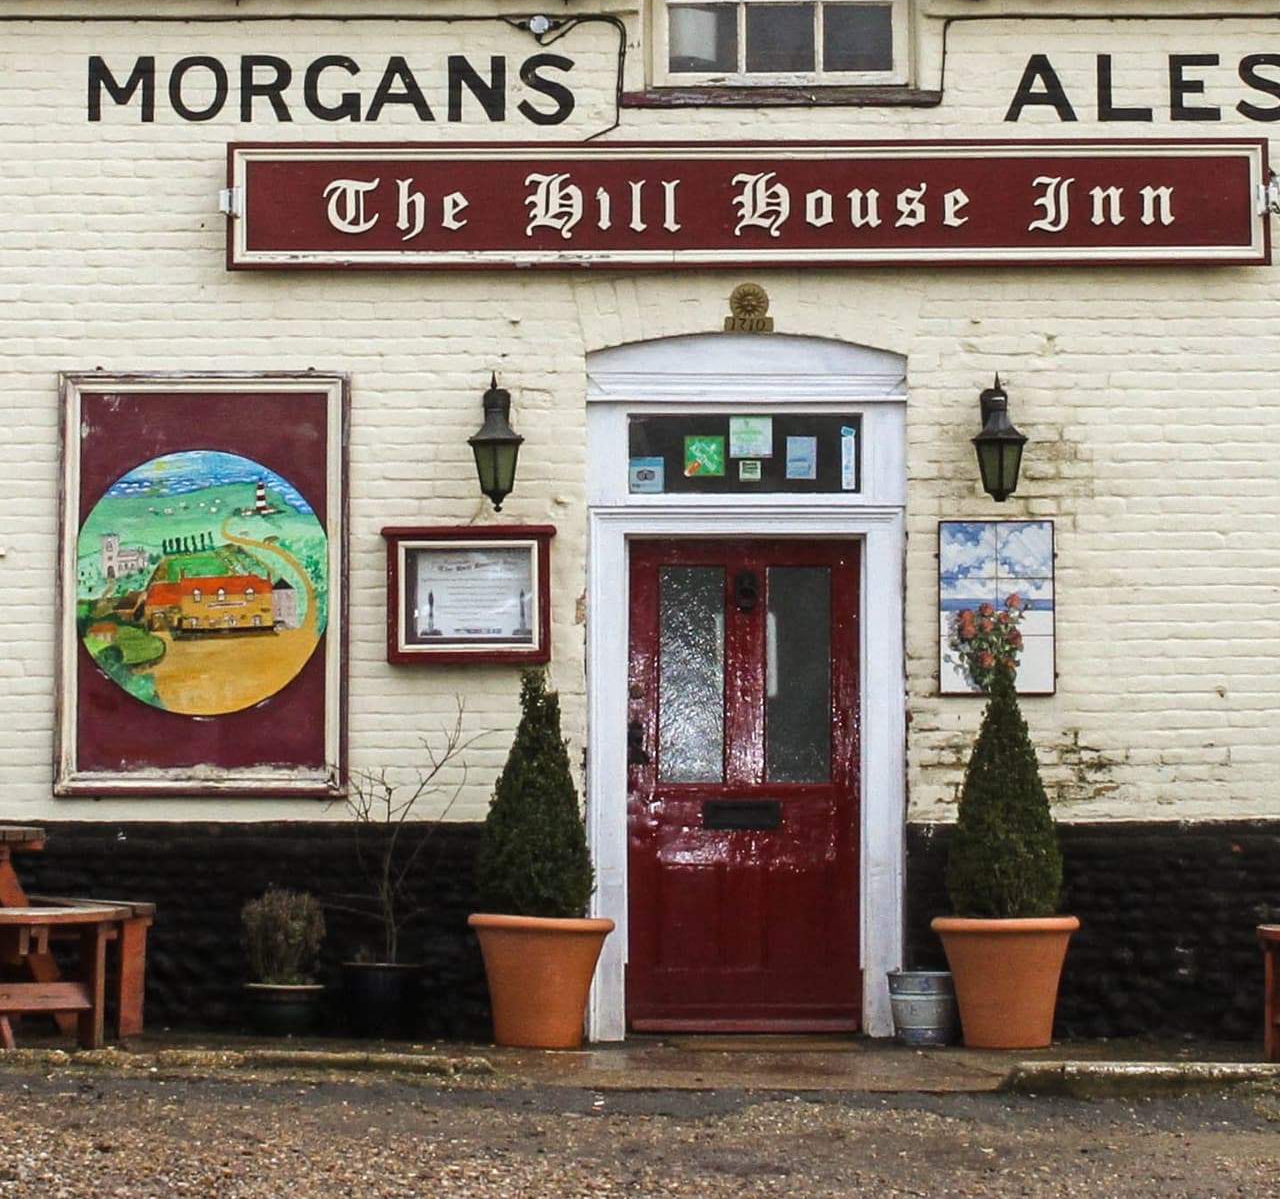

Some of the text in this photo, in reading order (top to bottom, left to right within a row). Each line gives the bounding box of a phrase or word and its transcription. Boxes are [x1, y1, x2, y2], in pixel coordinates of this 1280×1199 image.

[87, 54, 576, 126] MORGANS
[321, 170, 1177, 241] The Hill House Inn
